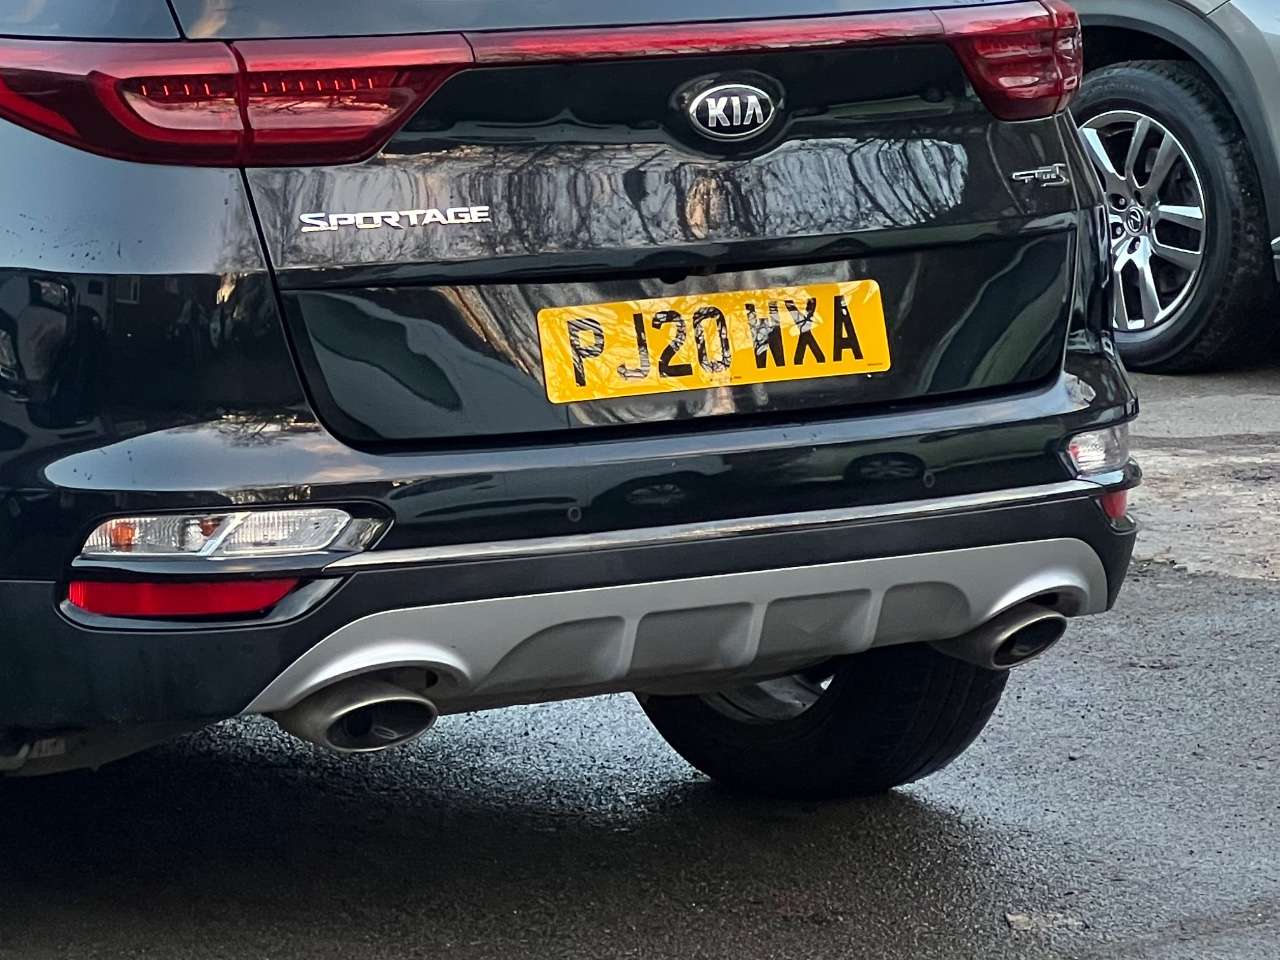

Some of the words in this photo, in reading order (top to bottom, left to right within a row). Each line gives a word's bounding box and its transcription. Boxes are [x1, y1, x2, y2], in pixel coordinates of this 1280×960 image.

[705, 95, 764, 127] KIA
[299, 205, 492, 233] SPORTAGE
[566, 306, 733, 387] PJ20
[745, 294, 864, 369] WXA
